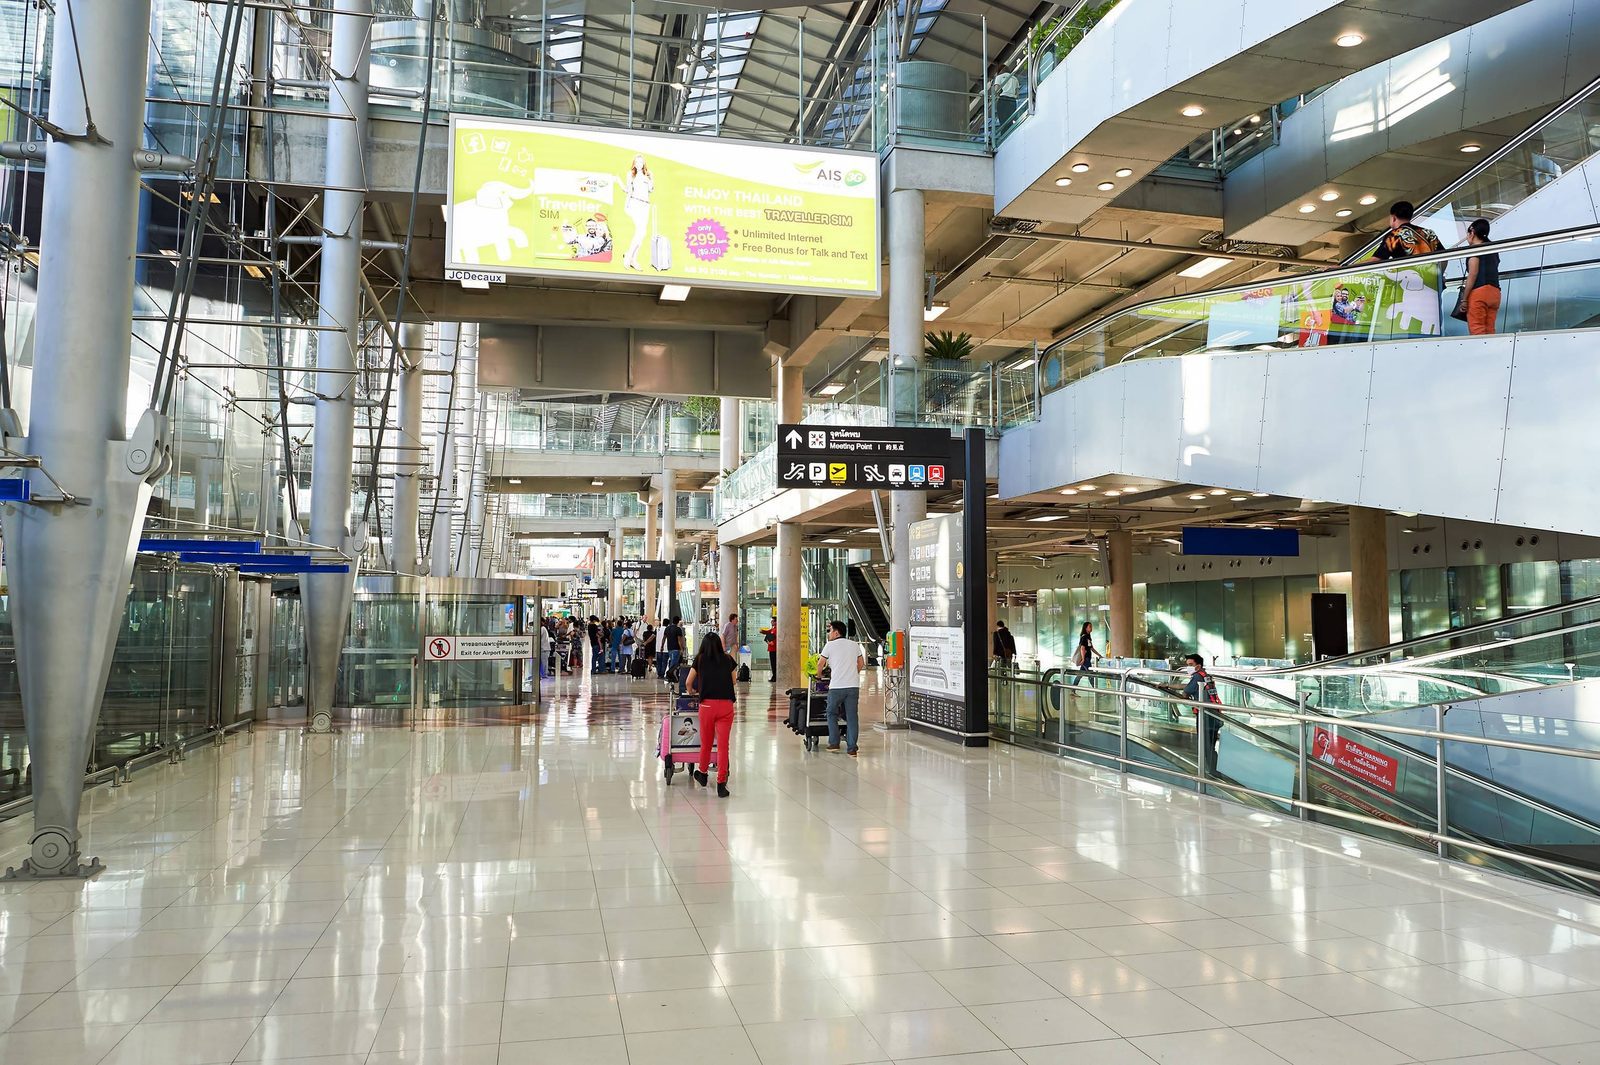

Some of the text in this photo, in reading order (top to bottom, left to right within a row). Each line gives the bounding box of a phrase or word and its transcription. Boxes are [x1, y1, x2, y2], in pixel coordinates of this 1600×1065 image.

[817, 169, 842, 181] AIS
[684, 186, 804, 207] ENJOY THAILAND
[538, 196, 601, 213] Traveller
[540, 209, 560, 219] SIM
[764, 209, 829, 225] TRAVELLER
[830, 213, 852, 226] SIM
[688, 232, 716, 246] 299
[742, 229, 823, 243] Unlimited Internet
[742, 243, 868, 260] Free Bonus for Talk and Text
[449, 271, 502, 282] JCDecaux
[829, 442, 873, 451] Meeting Point
